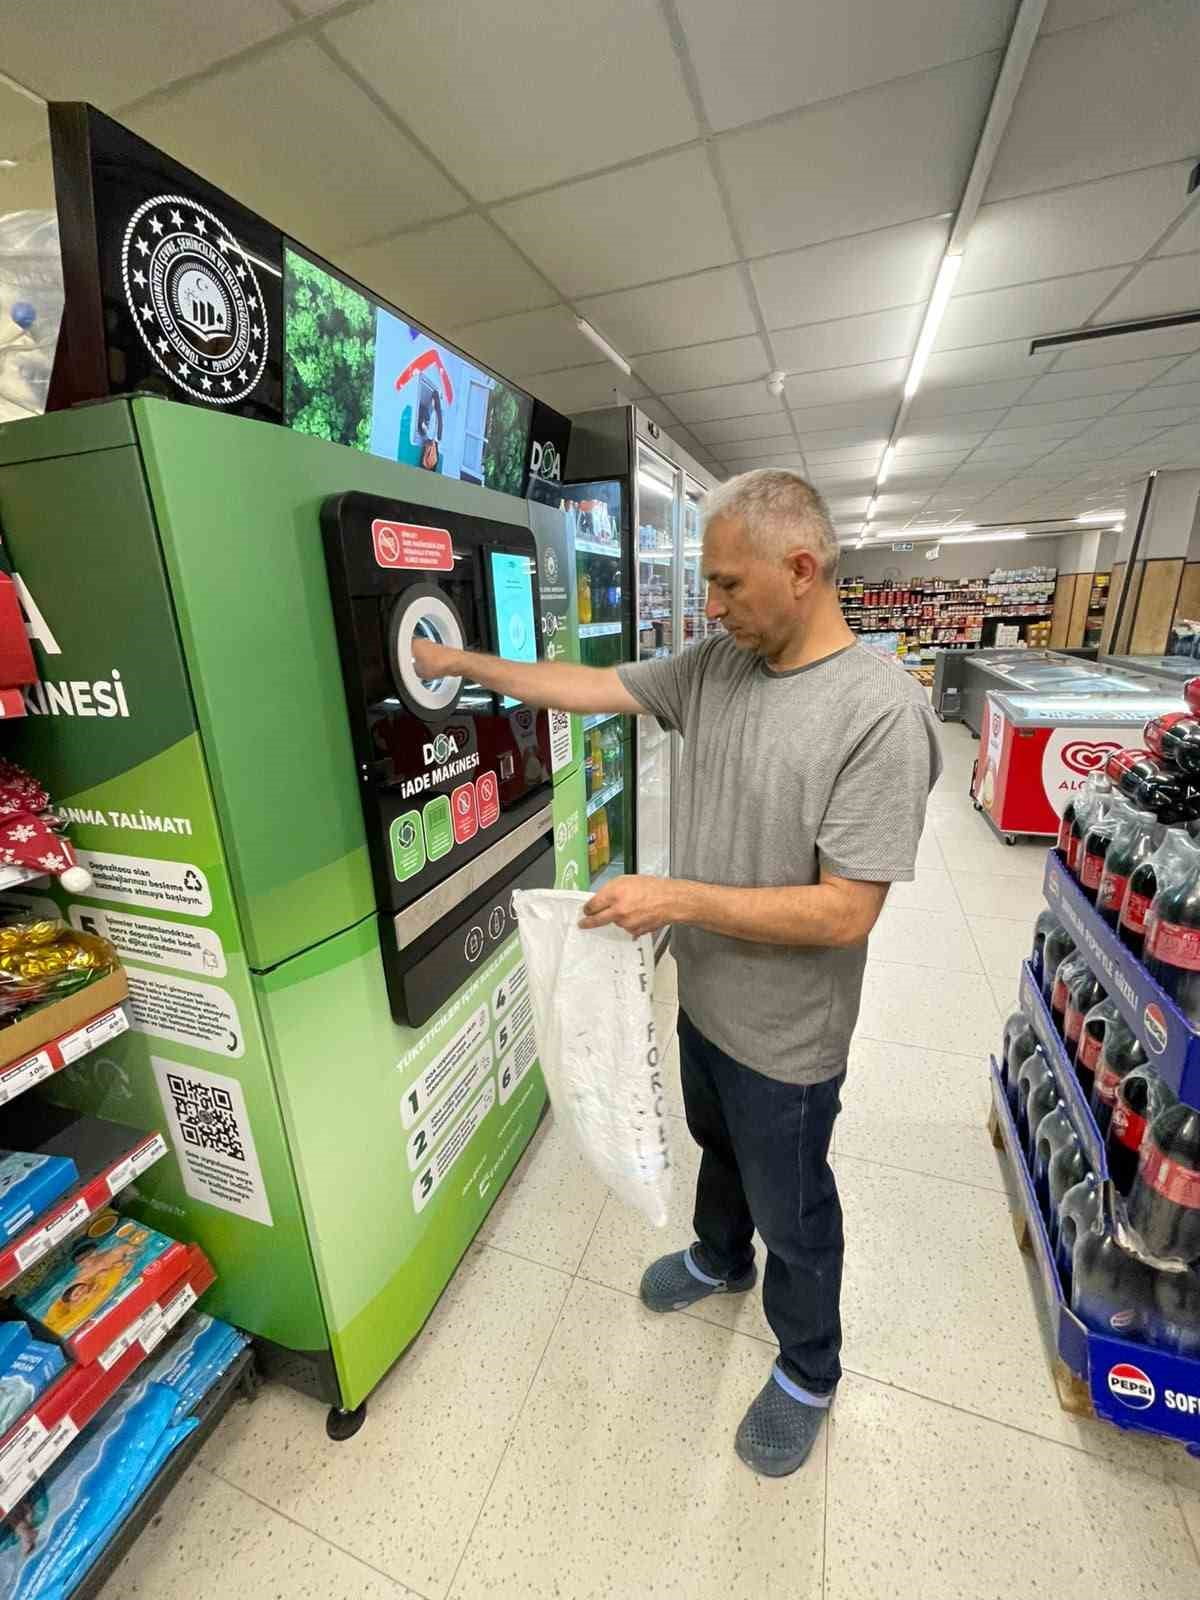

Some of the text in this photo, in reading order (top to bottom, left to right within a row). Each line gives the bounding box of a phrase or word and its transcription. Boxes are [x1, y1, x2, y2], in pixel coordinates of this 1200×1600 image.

[422, 733, 460, 767] DOA
[500, 1026, 509, 1050] 5
[502, 1067, 512, 1089] 6
[408, 1089, 420, 1115] 1
[413, 1130, 428, 1160] 2
[420, 1168, 435, 1199] 3
[1110, 1377, 1153, 1396] PEPSI
[1164, 1389, 1200, 1415] SOF
